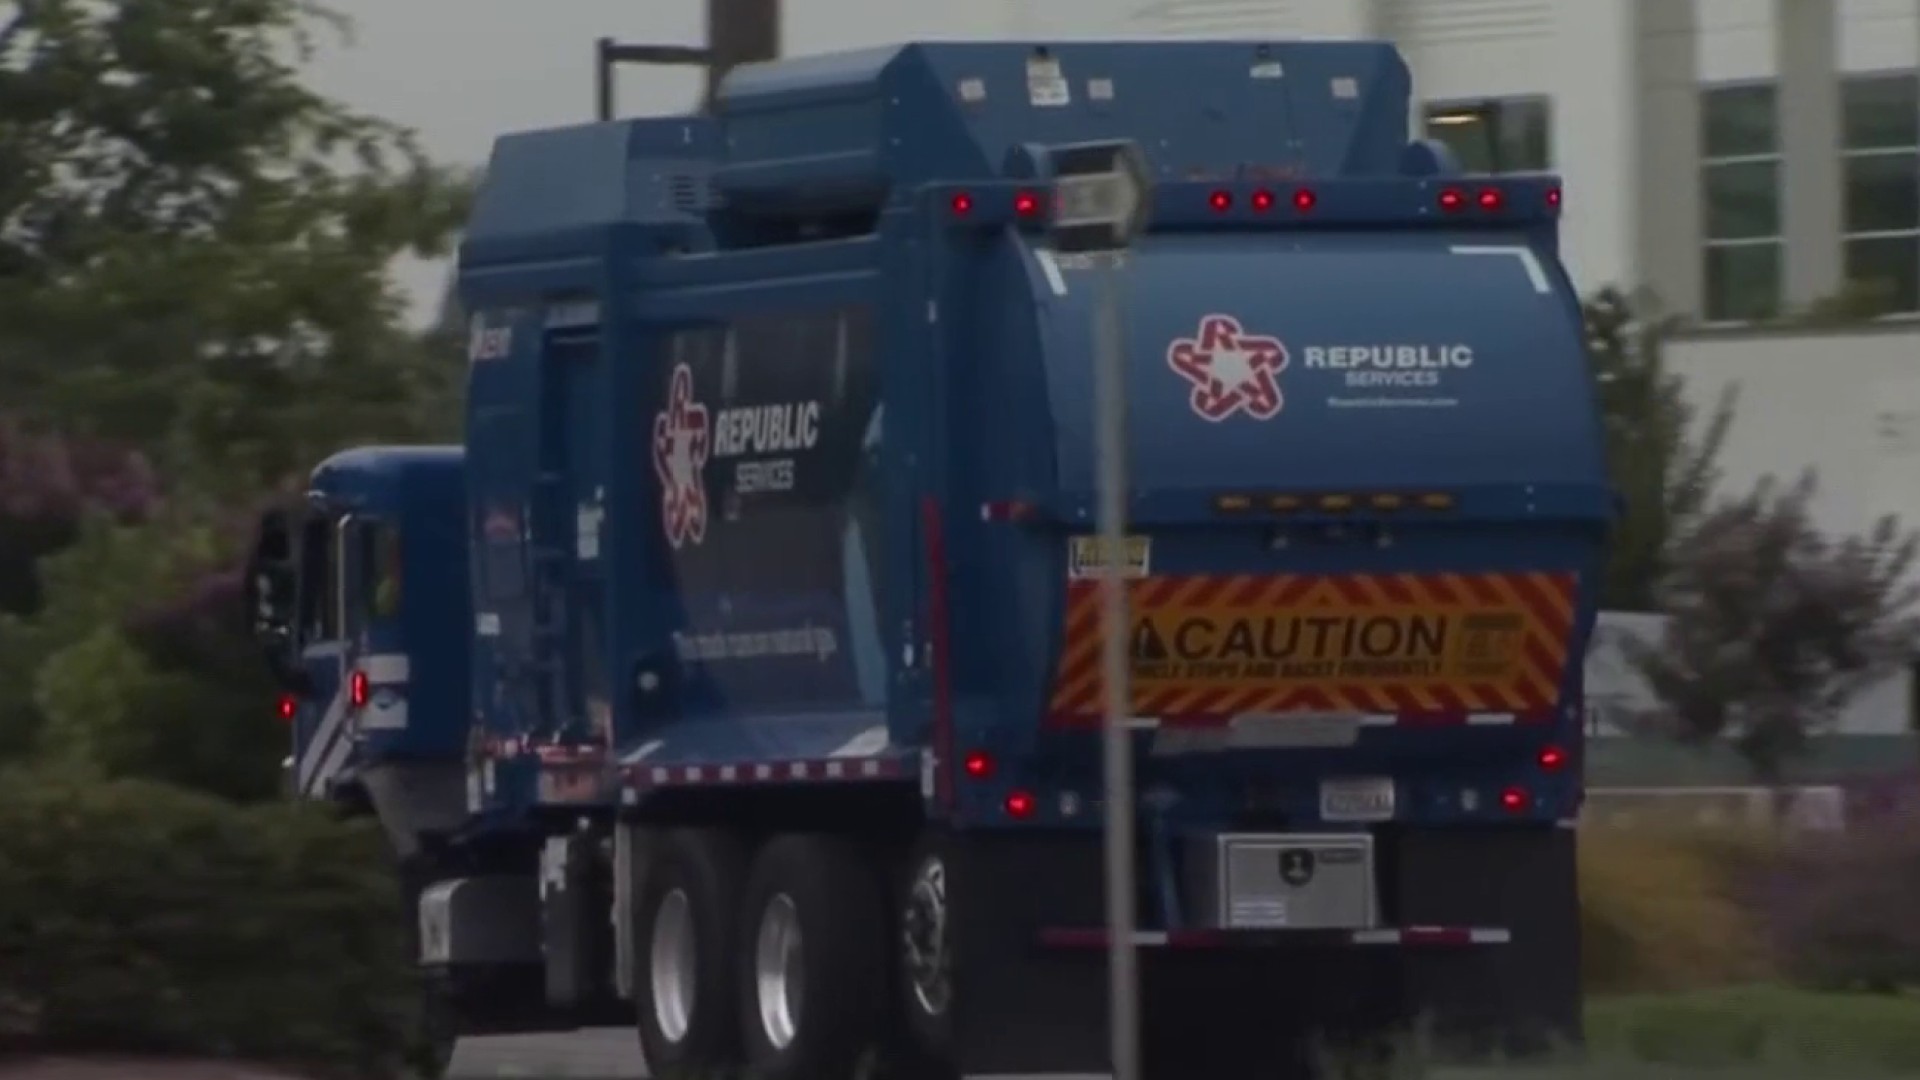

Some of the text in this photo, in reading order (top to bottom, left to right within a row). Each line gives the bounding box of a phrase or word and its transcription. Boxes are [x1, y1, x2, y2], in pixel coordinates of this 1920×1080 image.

[1303, 344, 1473, 369] REPUBLIC
[1345, 371, 1439, 387] SERVICES
[714, 400, 820, 457] REPUBLIC
[735, 458, 795, 493] SERVICES
[1175, 614, 1446, 659] CAUTION
